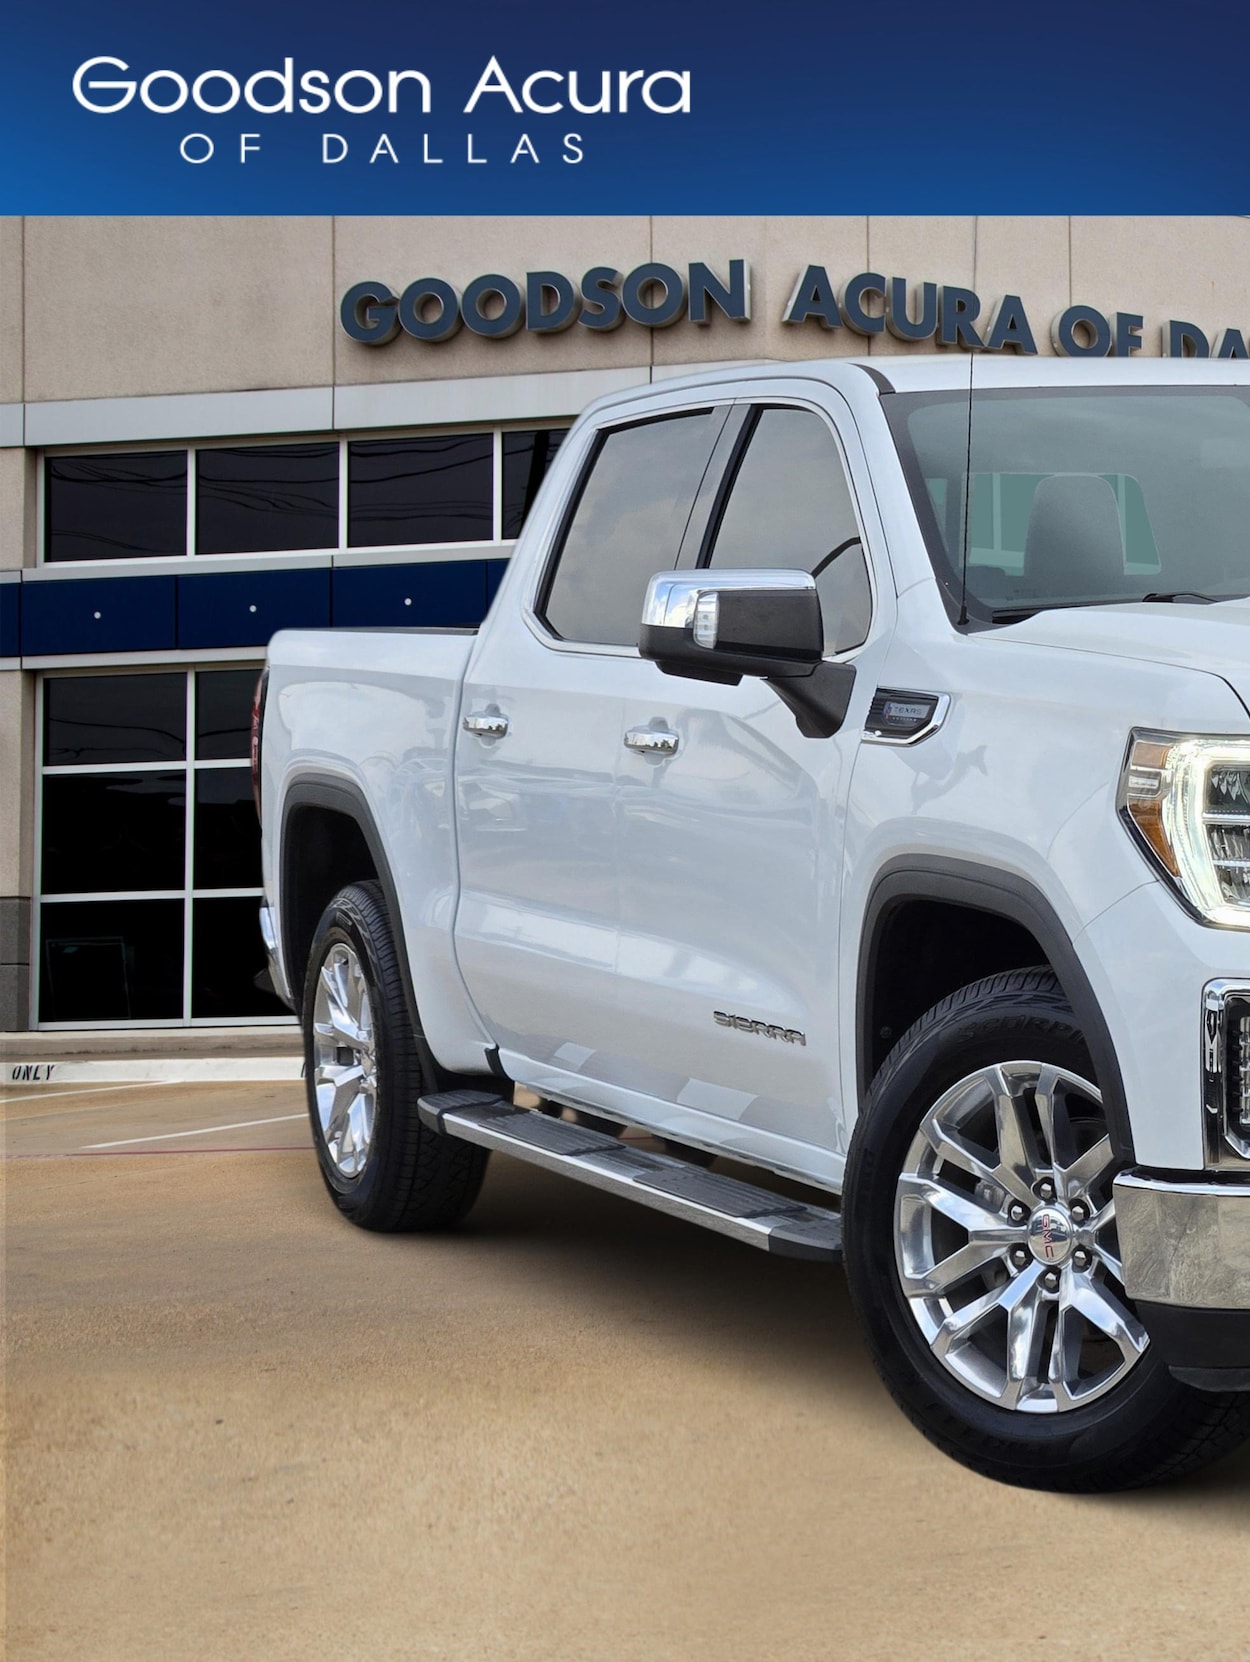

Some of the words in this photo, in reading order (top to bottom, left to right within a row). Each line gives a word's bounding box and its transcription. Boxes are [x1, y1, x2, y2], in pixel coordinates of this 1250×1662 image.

[339, 258, 752, 347] GOODSON
[782, 263, 1039, 356] ACURA
[1050, 303, 1144, 358] OF
[712, 1010, 807, 1047] SIERRA
[958, 1014, 1085, 1044] SCORPI
[11, 1064, 57, 1081] ONLY
[1041, 1213, 1055, 1259] GMC
